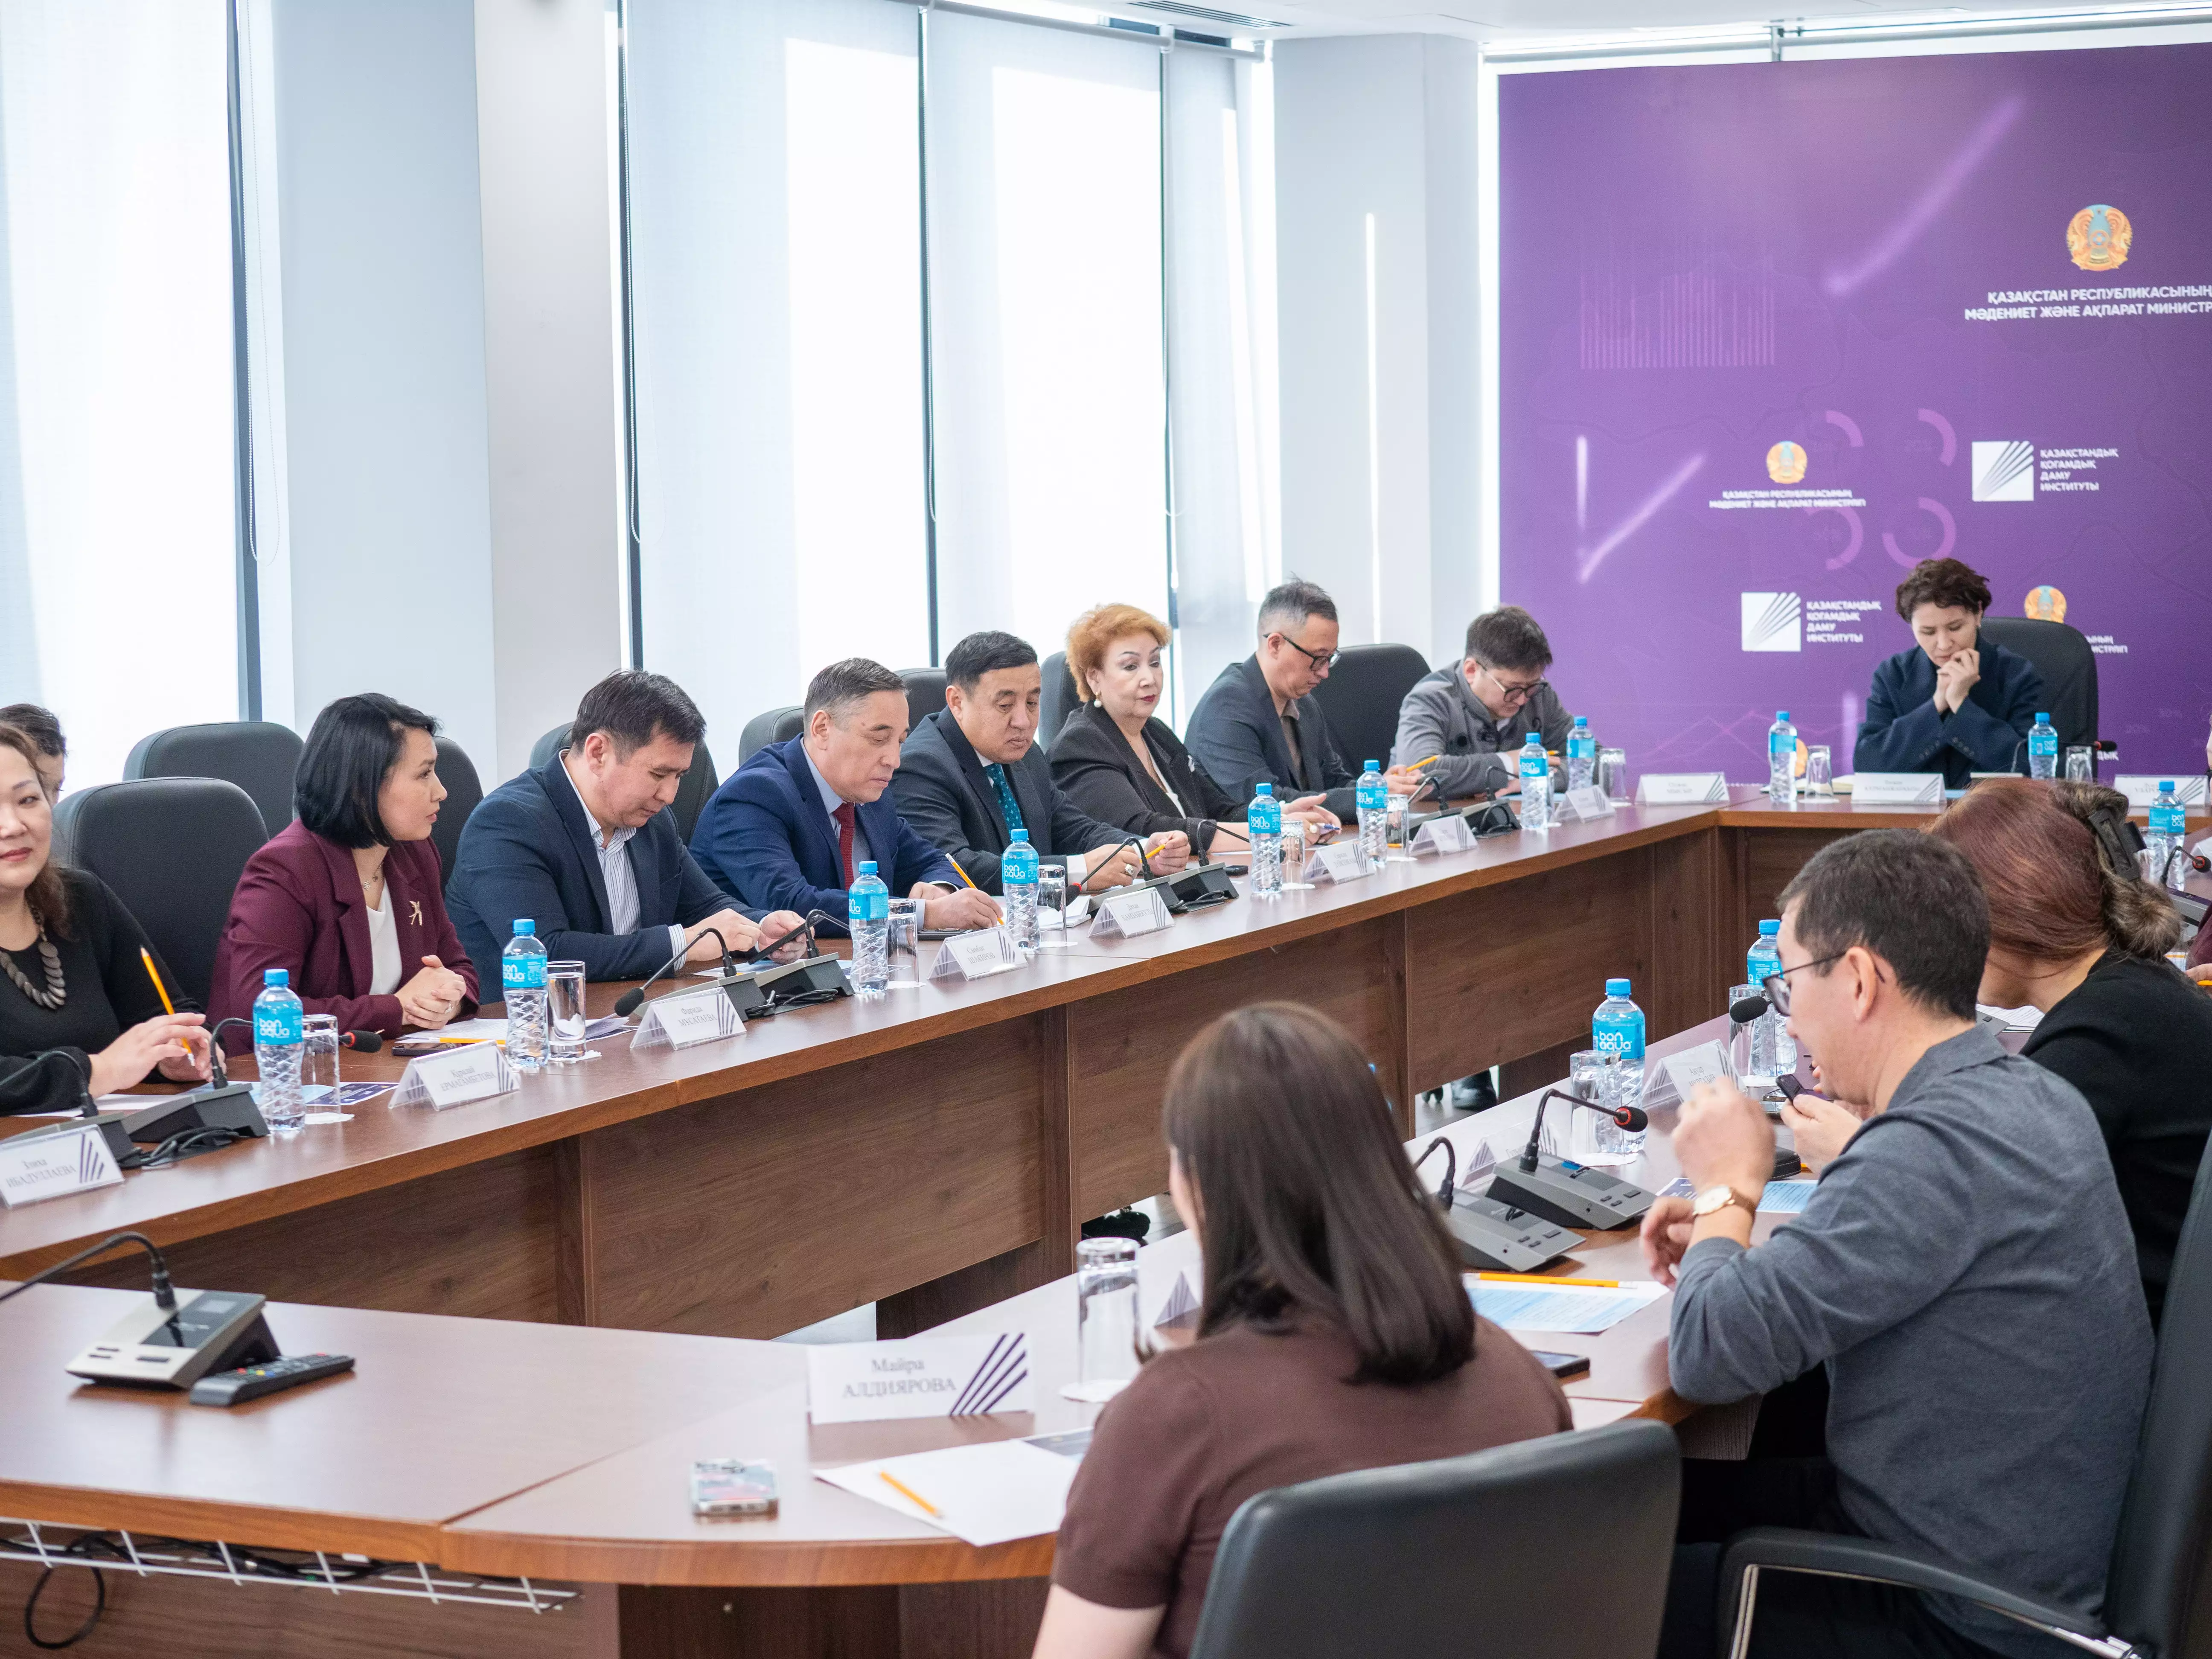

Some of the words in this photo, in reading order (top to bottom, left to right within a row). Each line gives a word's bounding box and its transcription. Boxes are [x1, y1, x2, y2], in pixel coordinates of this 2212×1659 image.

[1988, 289, 2068, 303] ҚАЗАҚСТАН
[1965, 307, 2037, 321] МӘДЕНИЕТ
[2040, 306, 2081, 318] ЖӘНЕ
[2083, 303, 2144, 317] АҚПАРАТ
[2040, 471, 2071, 481] ДАМУ
[1004, 863, 1019, 871] bon
[1005, 870, 1025, 879] aqua
[967, 952, 995, 964] ШАКИРОВ
[259, 1018, 282, 1028] bon
[678, 1013, 718, 1027] МУСАТАЕВА
[259, 1027, 290, 1038] aqua
[1599, 1030, 1623, 1042] bon
[1599, 1041, 1631, 1051] aqua
[871, 1356, 925, 1375] Майра
[841, 1377, 958, 1399] АЛДИЯРОВА
